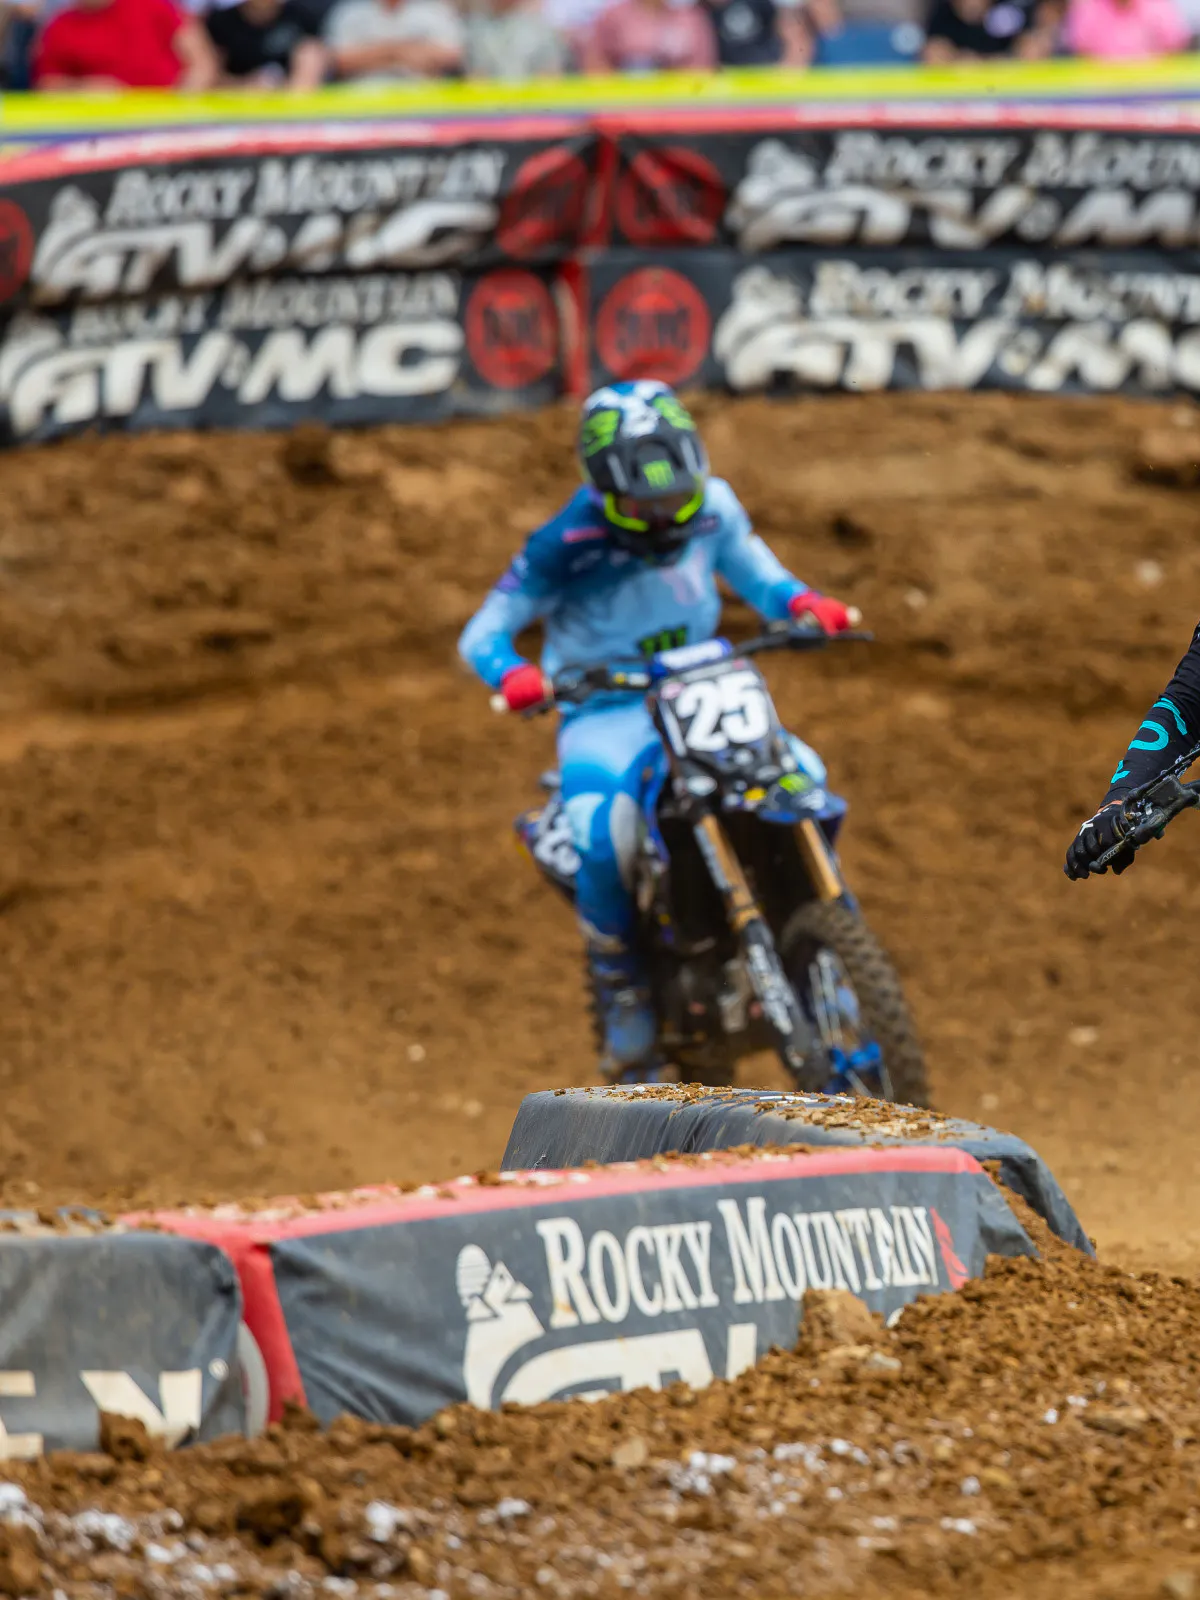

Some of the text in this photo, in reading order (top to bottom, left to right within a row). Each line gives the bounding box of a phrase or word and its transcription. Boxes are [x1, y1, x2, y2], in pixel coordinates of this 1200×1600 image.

[675, 670, 770, 752] 25
[536, 1196, 940, 1329] ROCKY MOUNTAIN
